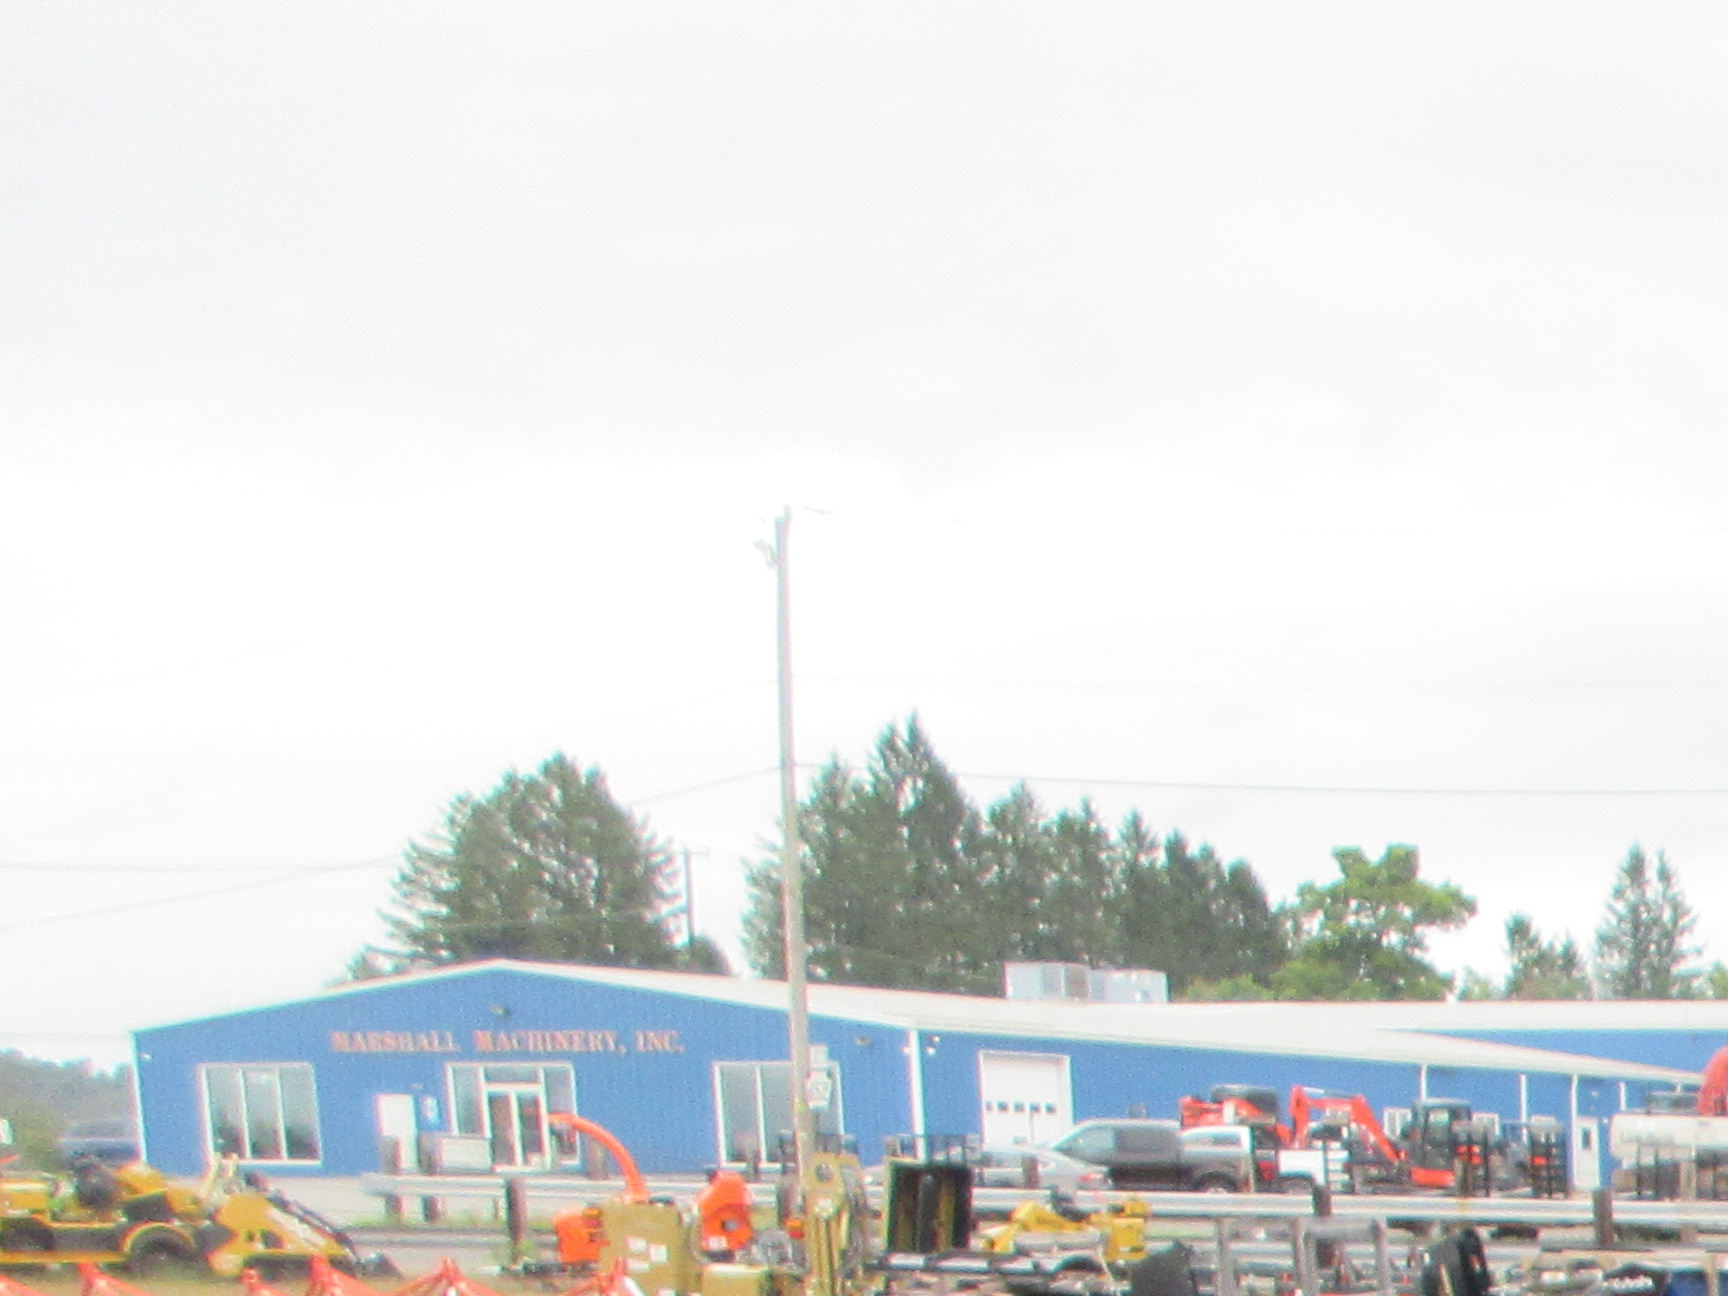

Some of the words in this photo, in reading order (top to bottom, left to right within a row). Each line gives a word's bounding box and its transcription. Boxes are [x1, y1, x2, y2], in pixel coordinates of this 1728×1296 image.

[330, 1030, 461, 1052] MARSHALL
[473, 1030, 627, 1055] MACHINERY,
[635, 1030, 685, 1053] INC.
